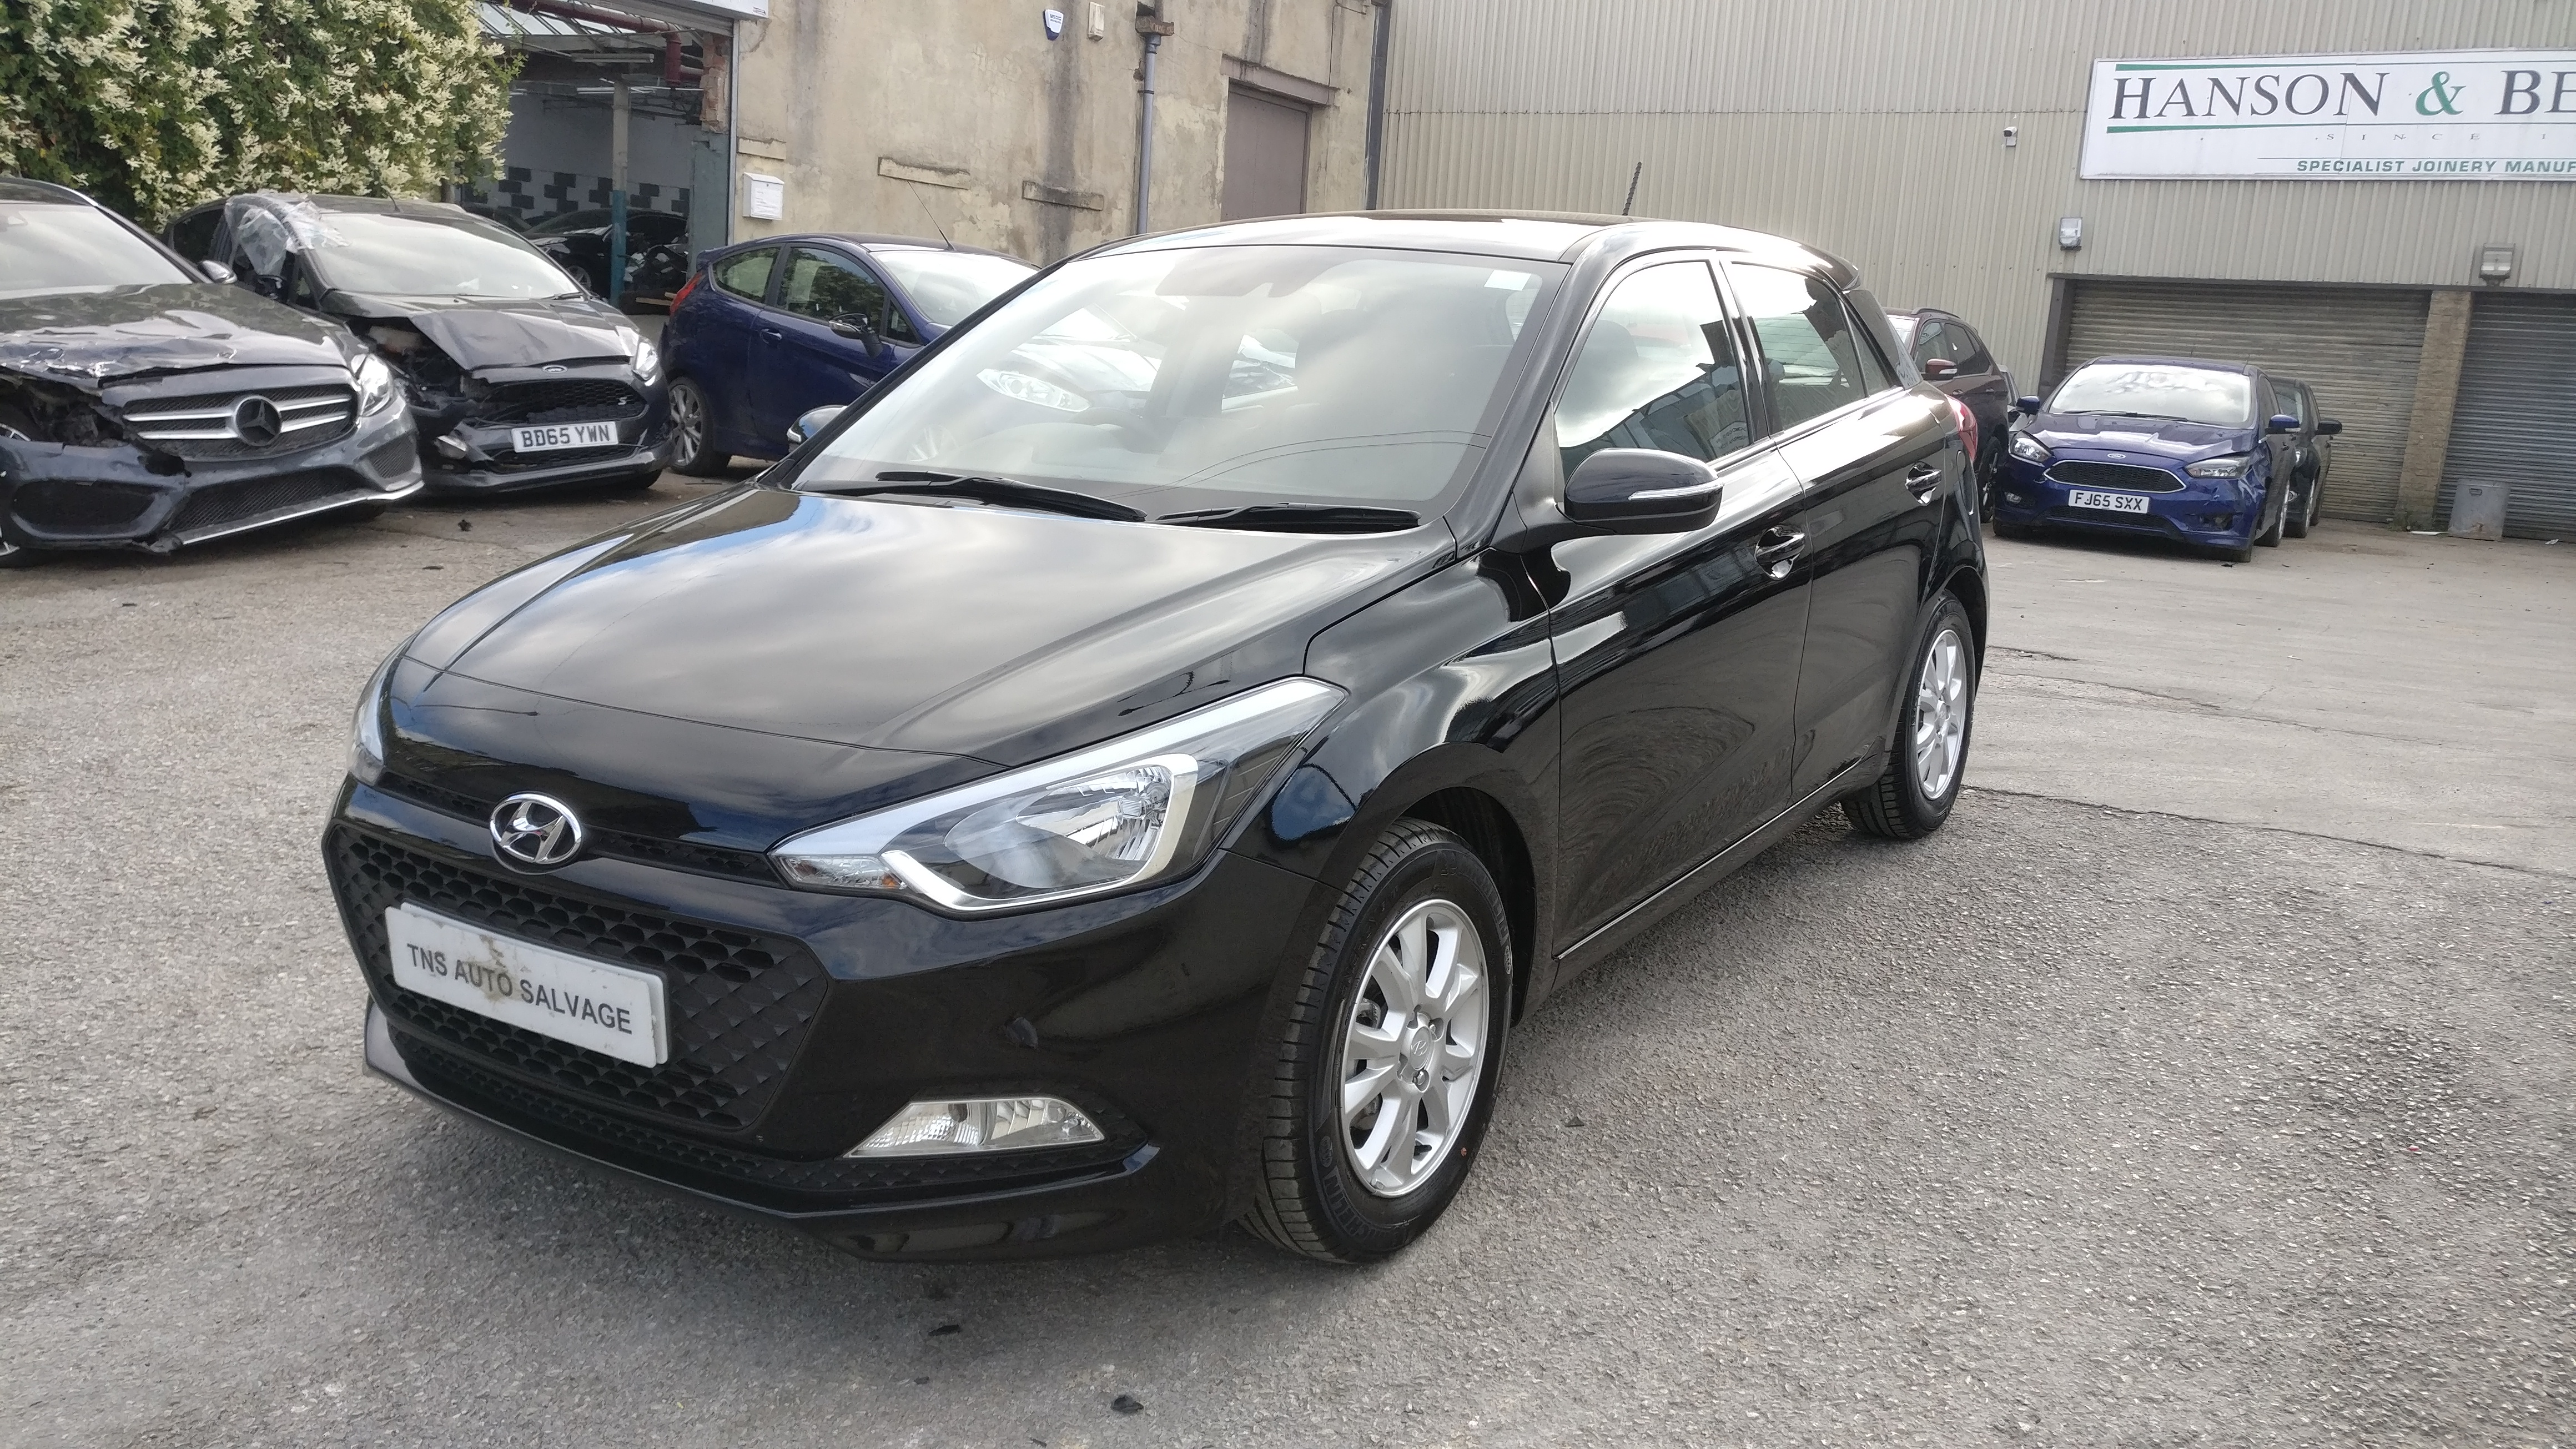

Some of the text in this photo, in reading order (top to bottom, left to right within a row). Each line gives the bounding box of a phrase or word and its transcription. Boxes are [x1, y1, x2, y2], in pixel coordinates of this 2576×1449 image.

[2108, 69, 2576, 119] HANSON & BE
[2297, 160, 2576, 173] SPECIALIST JOINERY MANUF
[521, 424, 611, 447] BD65 YWN
[2074, 492, 2143, 511] FJ65 SXX
[407, 944, 632, 1034] TNS AUTO SALVAGE
